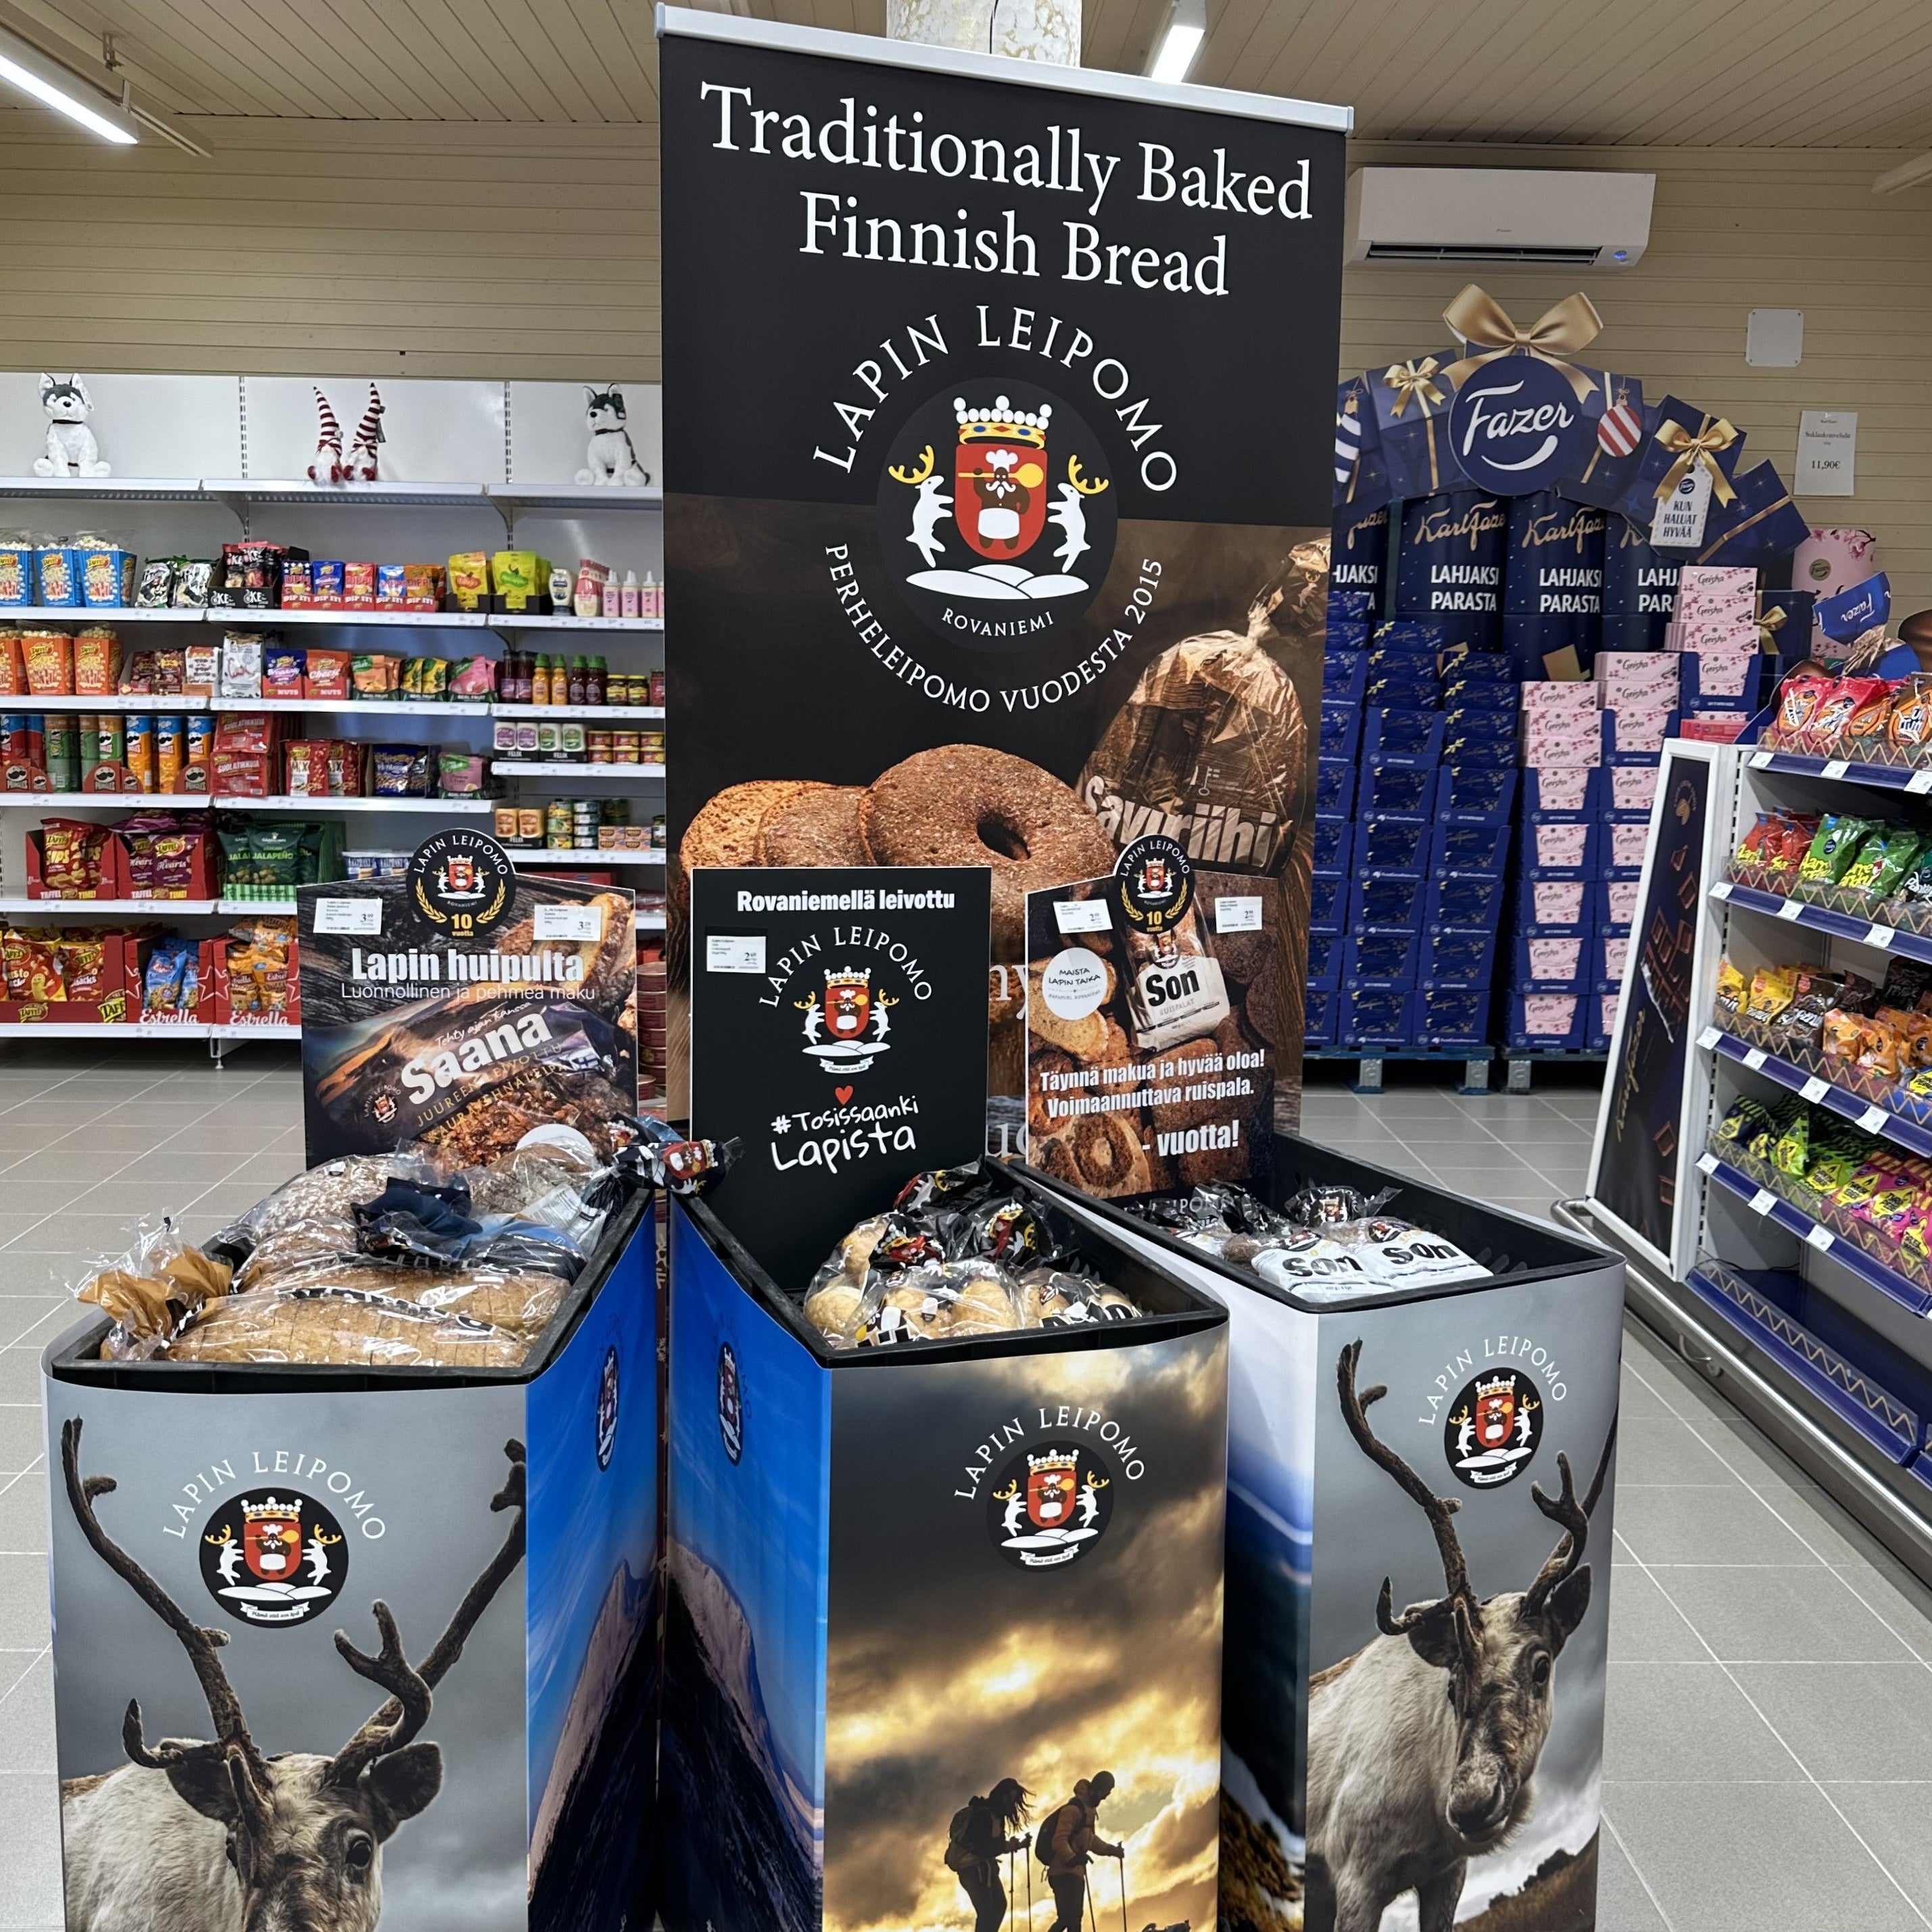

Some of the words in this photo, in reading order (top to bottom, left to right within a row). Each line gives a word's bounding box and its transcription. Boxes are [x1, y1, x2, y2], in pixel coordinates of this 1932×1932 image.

[700, 80, 1120, 216] Traditionally
[1137, 142, 1312, 220] Baked
[800, 191, 1038, 276] Finnish
[1062, 220, 1228, 296] Bread
[813, 314, 948, 473] LAPIN
[977, 305, 1177, 491] LEIPOMO
[1463, 380, 1574, 456] Fazer
[1812, 461, 1840, 470] 11,90€
[1673, 500, 1691, 511] KUN
[1414, 508, 1469, 545] Karl
[1457, 500, 1506, 551] Faze
[1522, 512, 1576, 548] Karl
[1663, 526, 1691, 537] HYVÄÄ
[1664, 514, 1697, 525] HALUAT
[1332, 564, 1378, 584] HJAKSI
[1431, 564, 1499, 586] LAHJAKSI
[1539, 568, 1602, 587] LAHJAKSI
[1638, 568, 1679, 586] LAHJ
[1431, 591, 1497, 611] PARASTA
[1540, 594, 1600, 613] PARASTA
[825, 544, 990, 712] PERHELEIPOMO
[1000, 629, 1133, 712] VUODESTA
[1126, 559, 1163, 624] 2015
[942, 608, 1054, 636] ROVANIEMI
[414, 838, 446, 873] LAPIN
[453, 836, 508, 874] LEIPOMO
[1120, 844, 1145, 876] LAPIN
[1150, 840, 1190, 873] LEIPOMO
[41, 890, 62, 899] TAFFEL
[131, 890, 153, 899] TAFFEL
[738, 890, 875, 911] Rovaniemellä
[879, 890, 955, 910] leivottu
[451, 914, 473, 929] 10
[1146, 911, 1162, 925] 10
[352, 948, 439, 983] Lapin
[448, 948, 584, 984] huipulta
[759, 934, 822, 1007] LAPIN
[834, 925, 932, 1000] LEIPOMO
[1059, 968, 1090, 976] MAISTA
[1048, 977, 1074, 986] LAPIN
[1076, 974, 1101, 985] TAIKA
[1146, 970, 1200, 1007] Son
[341, 983, 450, 999] Luonnollinen
[455, 984, 470, 1003] ja
[477, 983, 544, 1003] pehmeä
[550, 984, 595, 1000] maku
[101, 1001, 126, 1015] TAFF
[139, 1009, 199, 1024] Estrella
[230, 1010, 289, 1026] Estrella
[401, 1008, 553, 1105] Saana
[1040, 1069, 1100, 1092] Täynnä
[1103, 1061, 1155, 1082] makua
[1158, 1060, 1174, 1079] ja
[1178, 1053, 1224, 1078] hyvää
[1226, 1049, 1265, 1071] oloa!
[416, 1078, 482, 1128] JUUREEN
[1048, 1087, 1182, 1119] Voimaannuttava
[1185, 1078, 1255, 1103] ruispala.
[771, 1096, 919, 1134] #Tosissaanki
[771, 1124, 916, 1174] Lapista
[1157, 1119, 1239, 1157] vuotta!
[1382, 1242, 1459, 1264] Son
[1282, 1255, 1363, 1277] Son
[1418, 1349, 1473, 1425] LAPIN
[1484, 1336, 1566, 1401] LEIPOMO
[954, 1418, 1024, 1499] LAPIN
[1038, 1405, 1144, 1480] LEIPOMO
[163, 1459, 237, 1539] LAPIN
[252, 1450, 386, 1539] LEIPOMO
